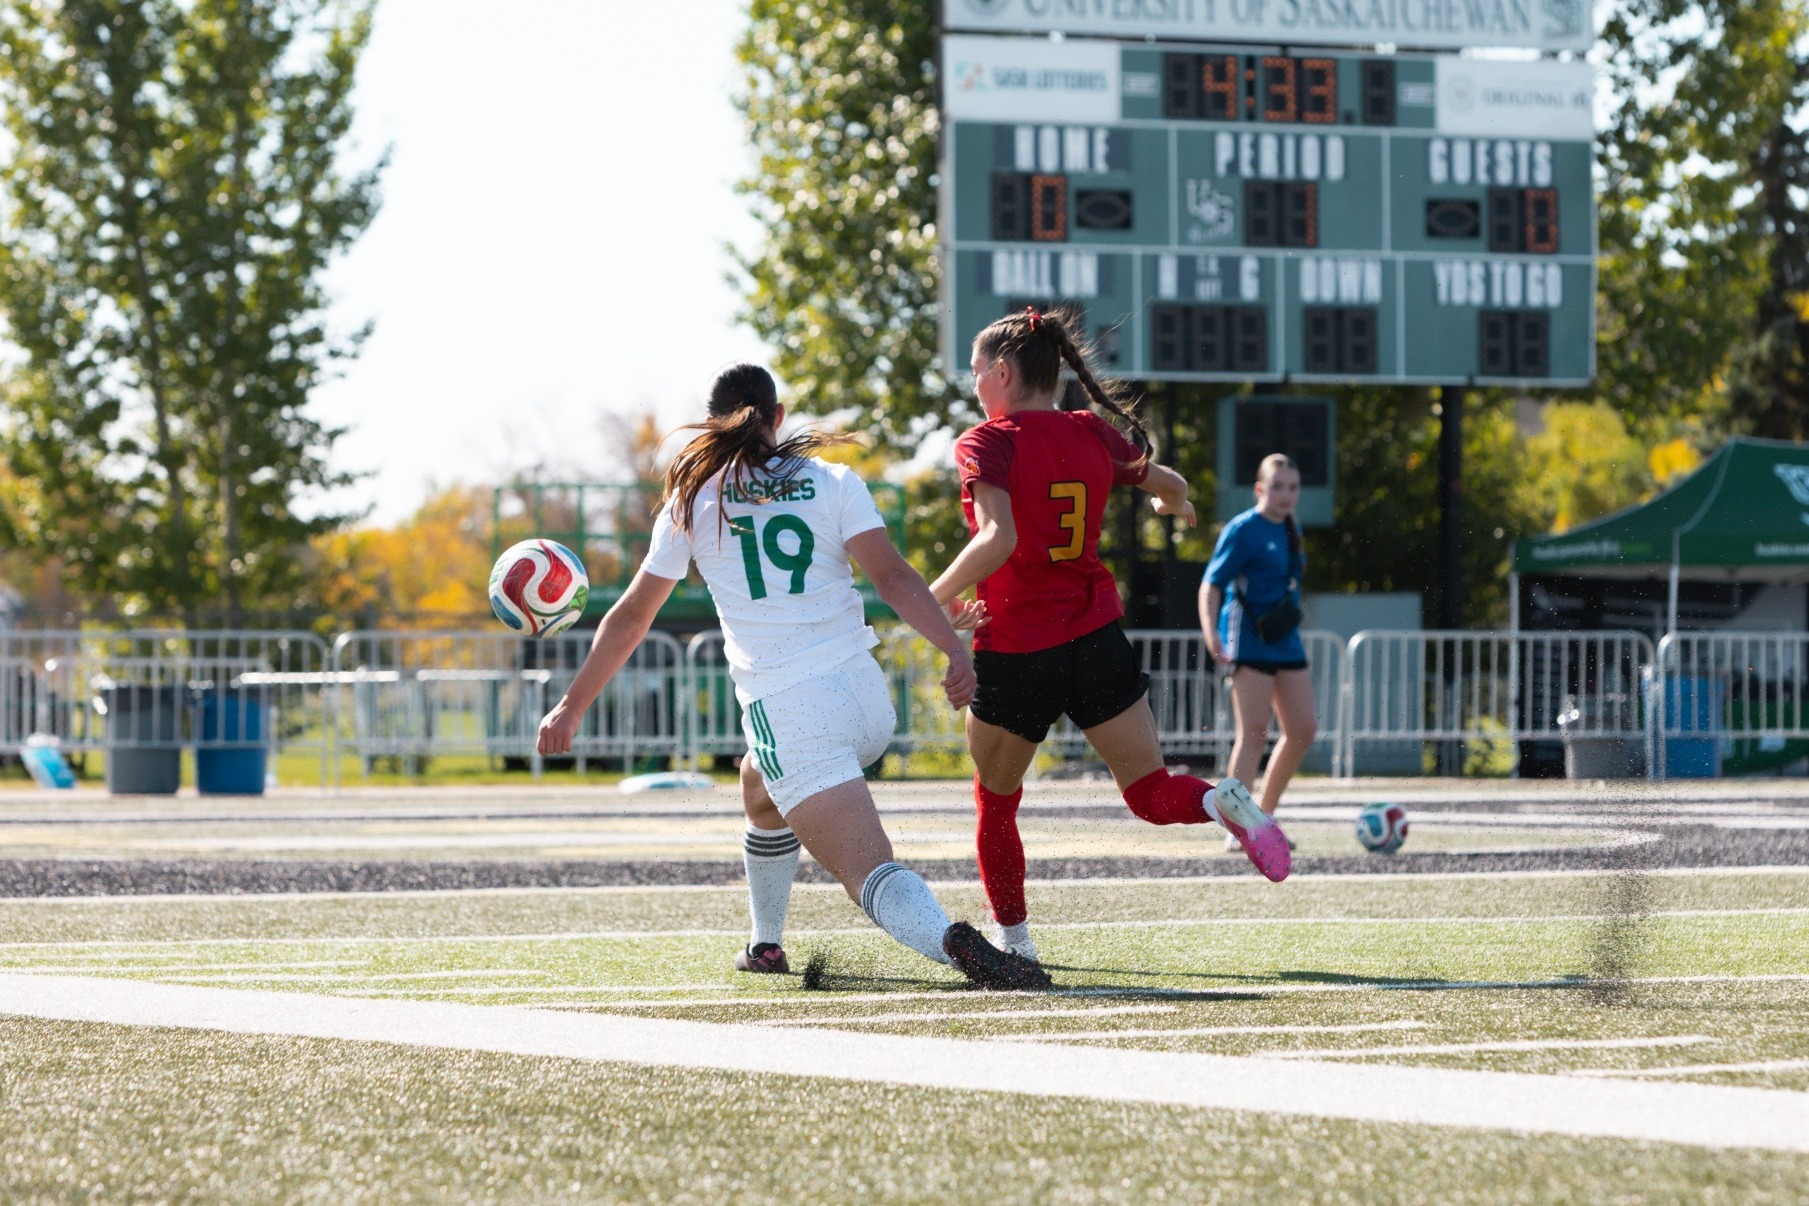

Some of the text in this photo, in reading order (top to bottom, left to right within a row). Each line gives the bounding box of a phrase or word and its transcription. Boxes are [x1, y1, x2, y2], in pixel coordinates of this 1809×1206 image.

[1278, 0, 1531, 34] SASKATCHEWAN
[1203, 55, 1335, 123] 4:33
[1014, 125, 1110, 174] HOME
[1215, 131, 1345, 181] PERIOD
[1428, 138, 1552, 187] GUESTS
[1031, 174, 1066, 240] 0
[1525, 188, 1557, 254] 0
[992, 251, 1098, 298] BALL ON
[1301, 256, 1382, 303] DOWN
[1434, 260, 1563, 309] YDS TO GO
[721, 477, 816, 504] HUSKIES
[1047, 480, 1087, 563] 3
[729, 513, 815, 600] 19
